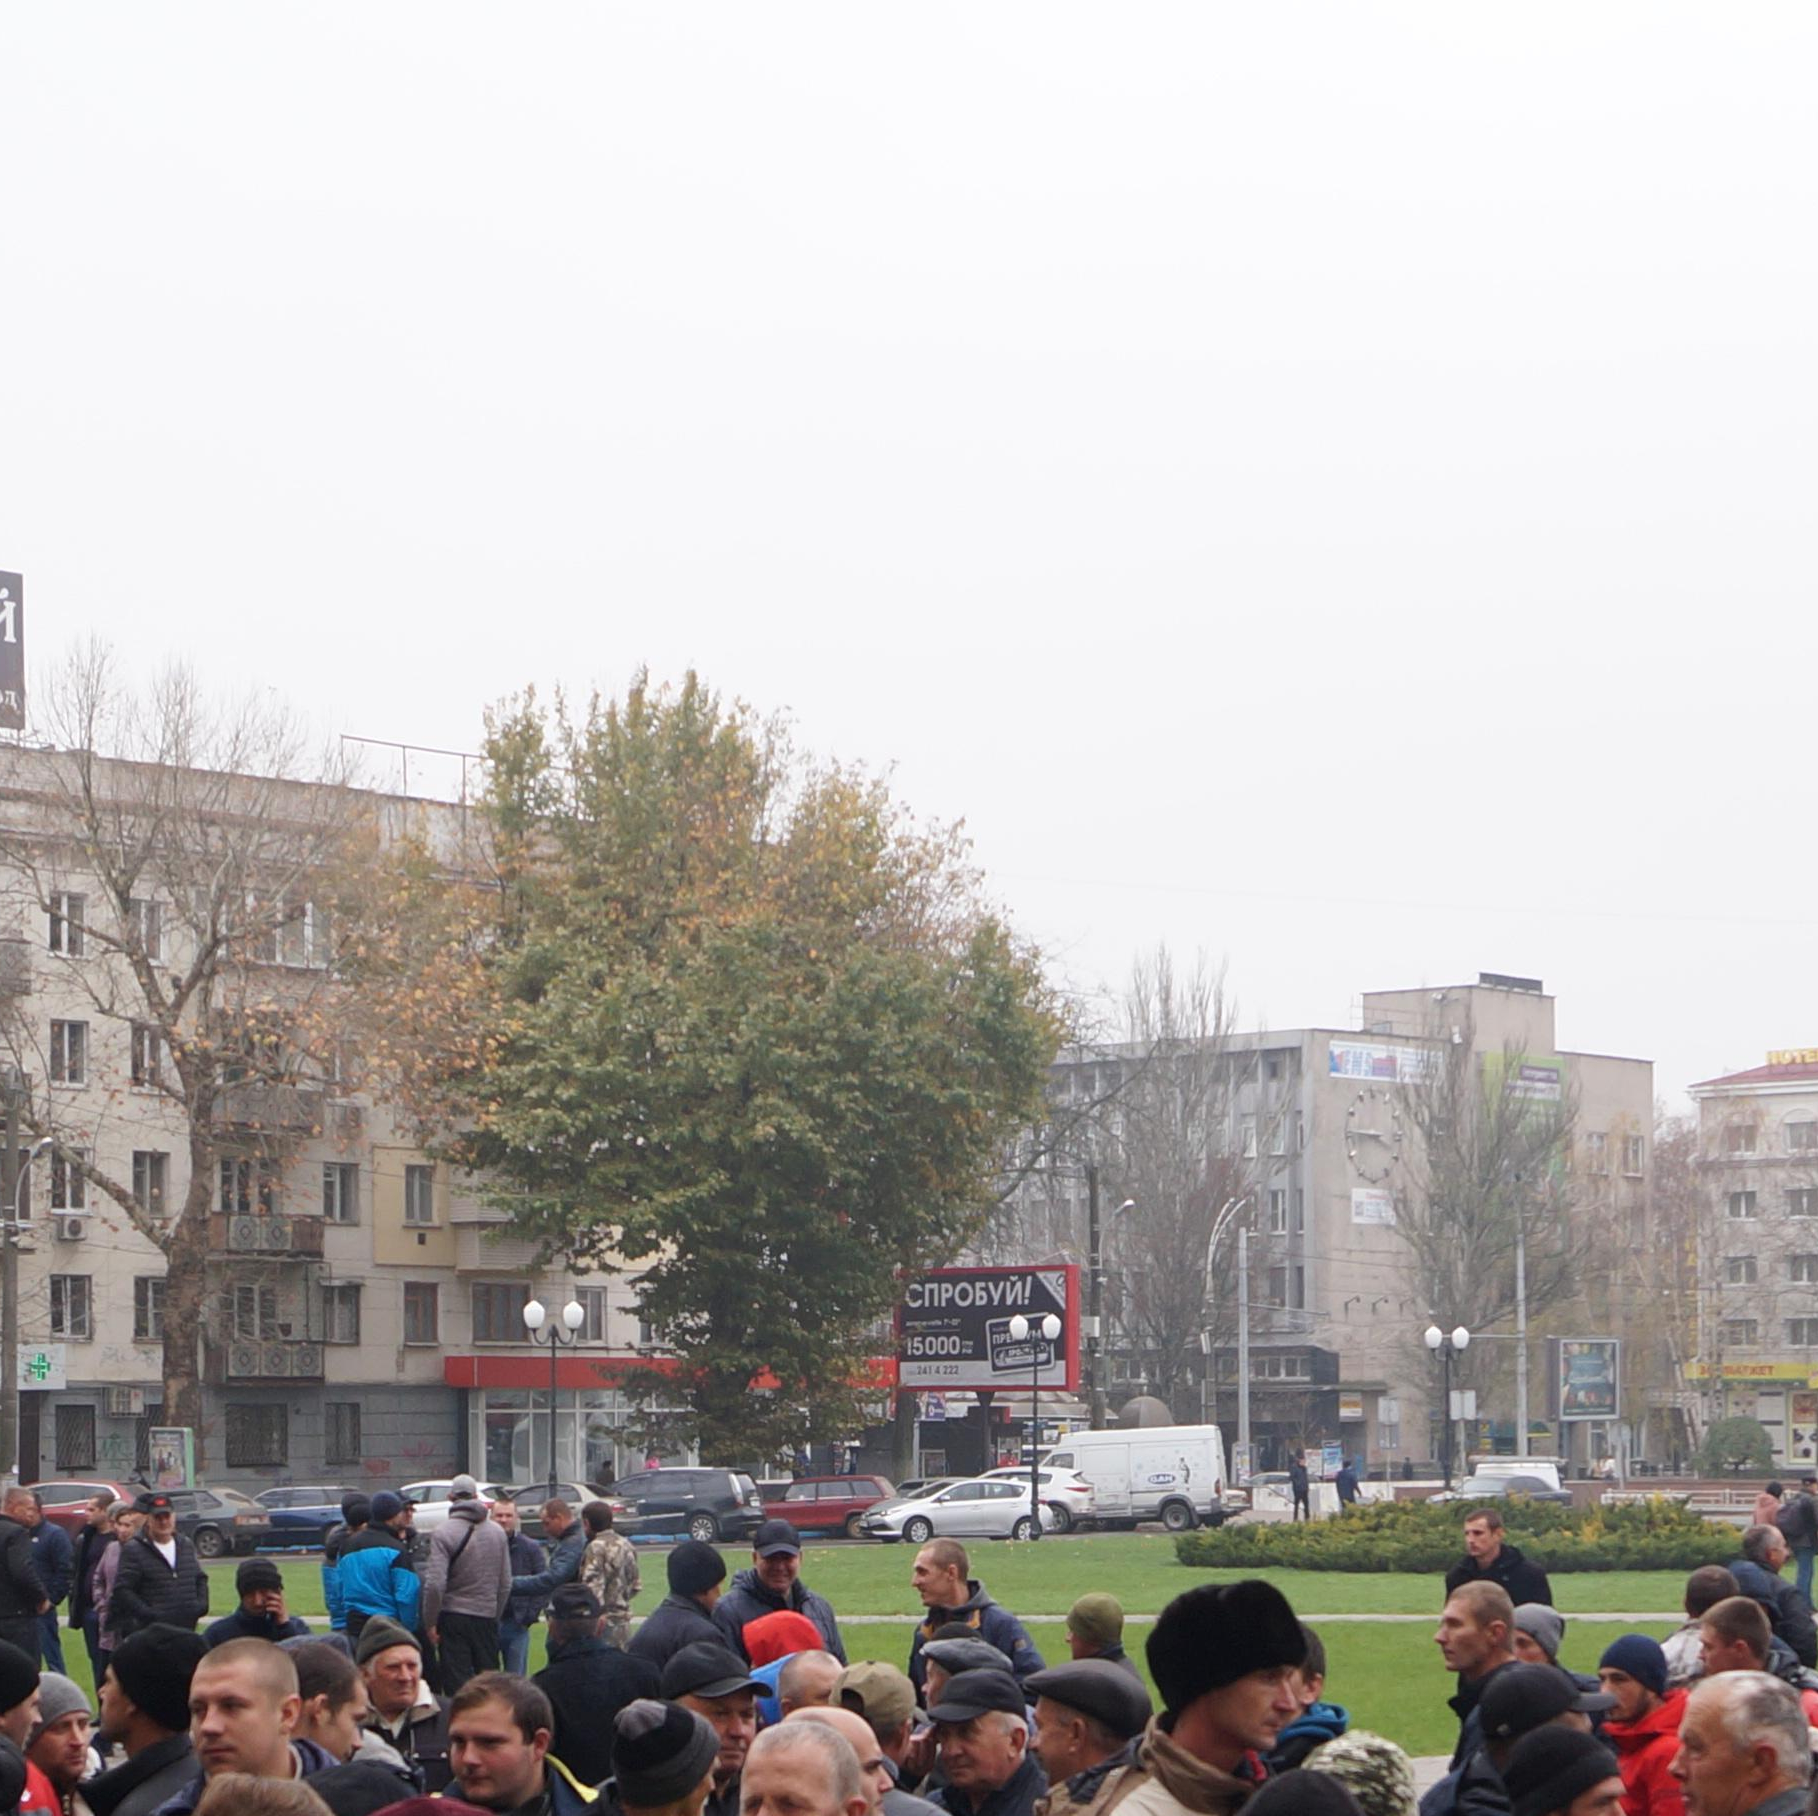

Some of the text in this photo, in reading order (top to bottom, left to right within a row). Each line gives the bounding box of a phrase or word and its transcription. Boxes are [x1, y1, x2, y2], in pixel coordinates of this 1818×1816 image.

[905, 1275, 1033, 1309] СПРОБУЙ!
[906, 1335, 960, 1356] 15000
[992, 1328, 1042, 1345] ПРЕУМ
